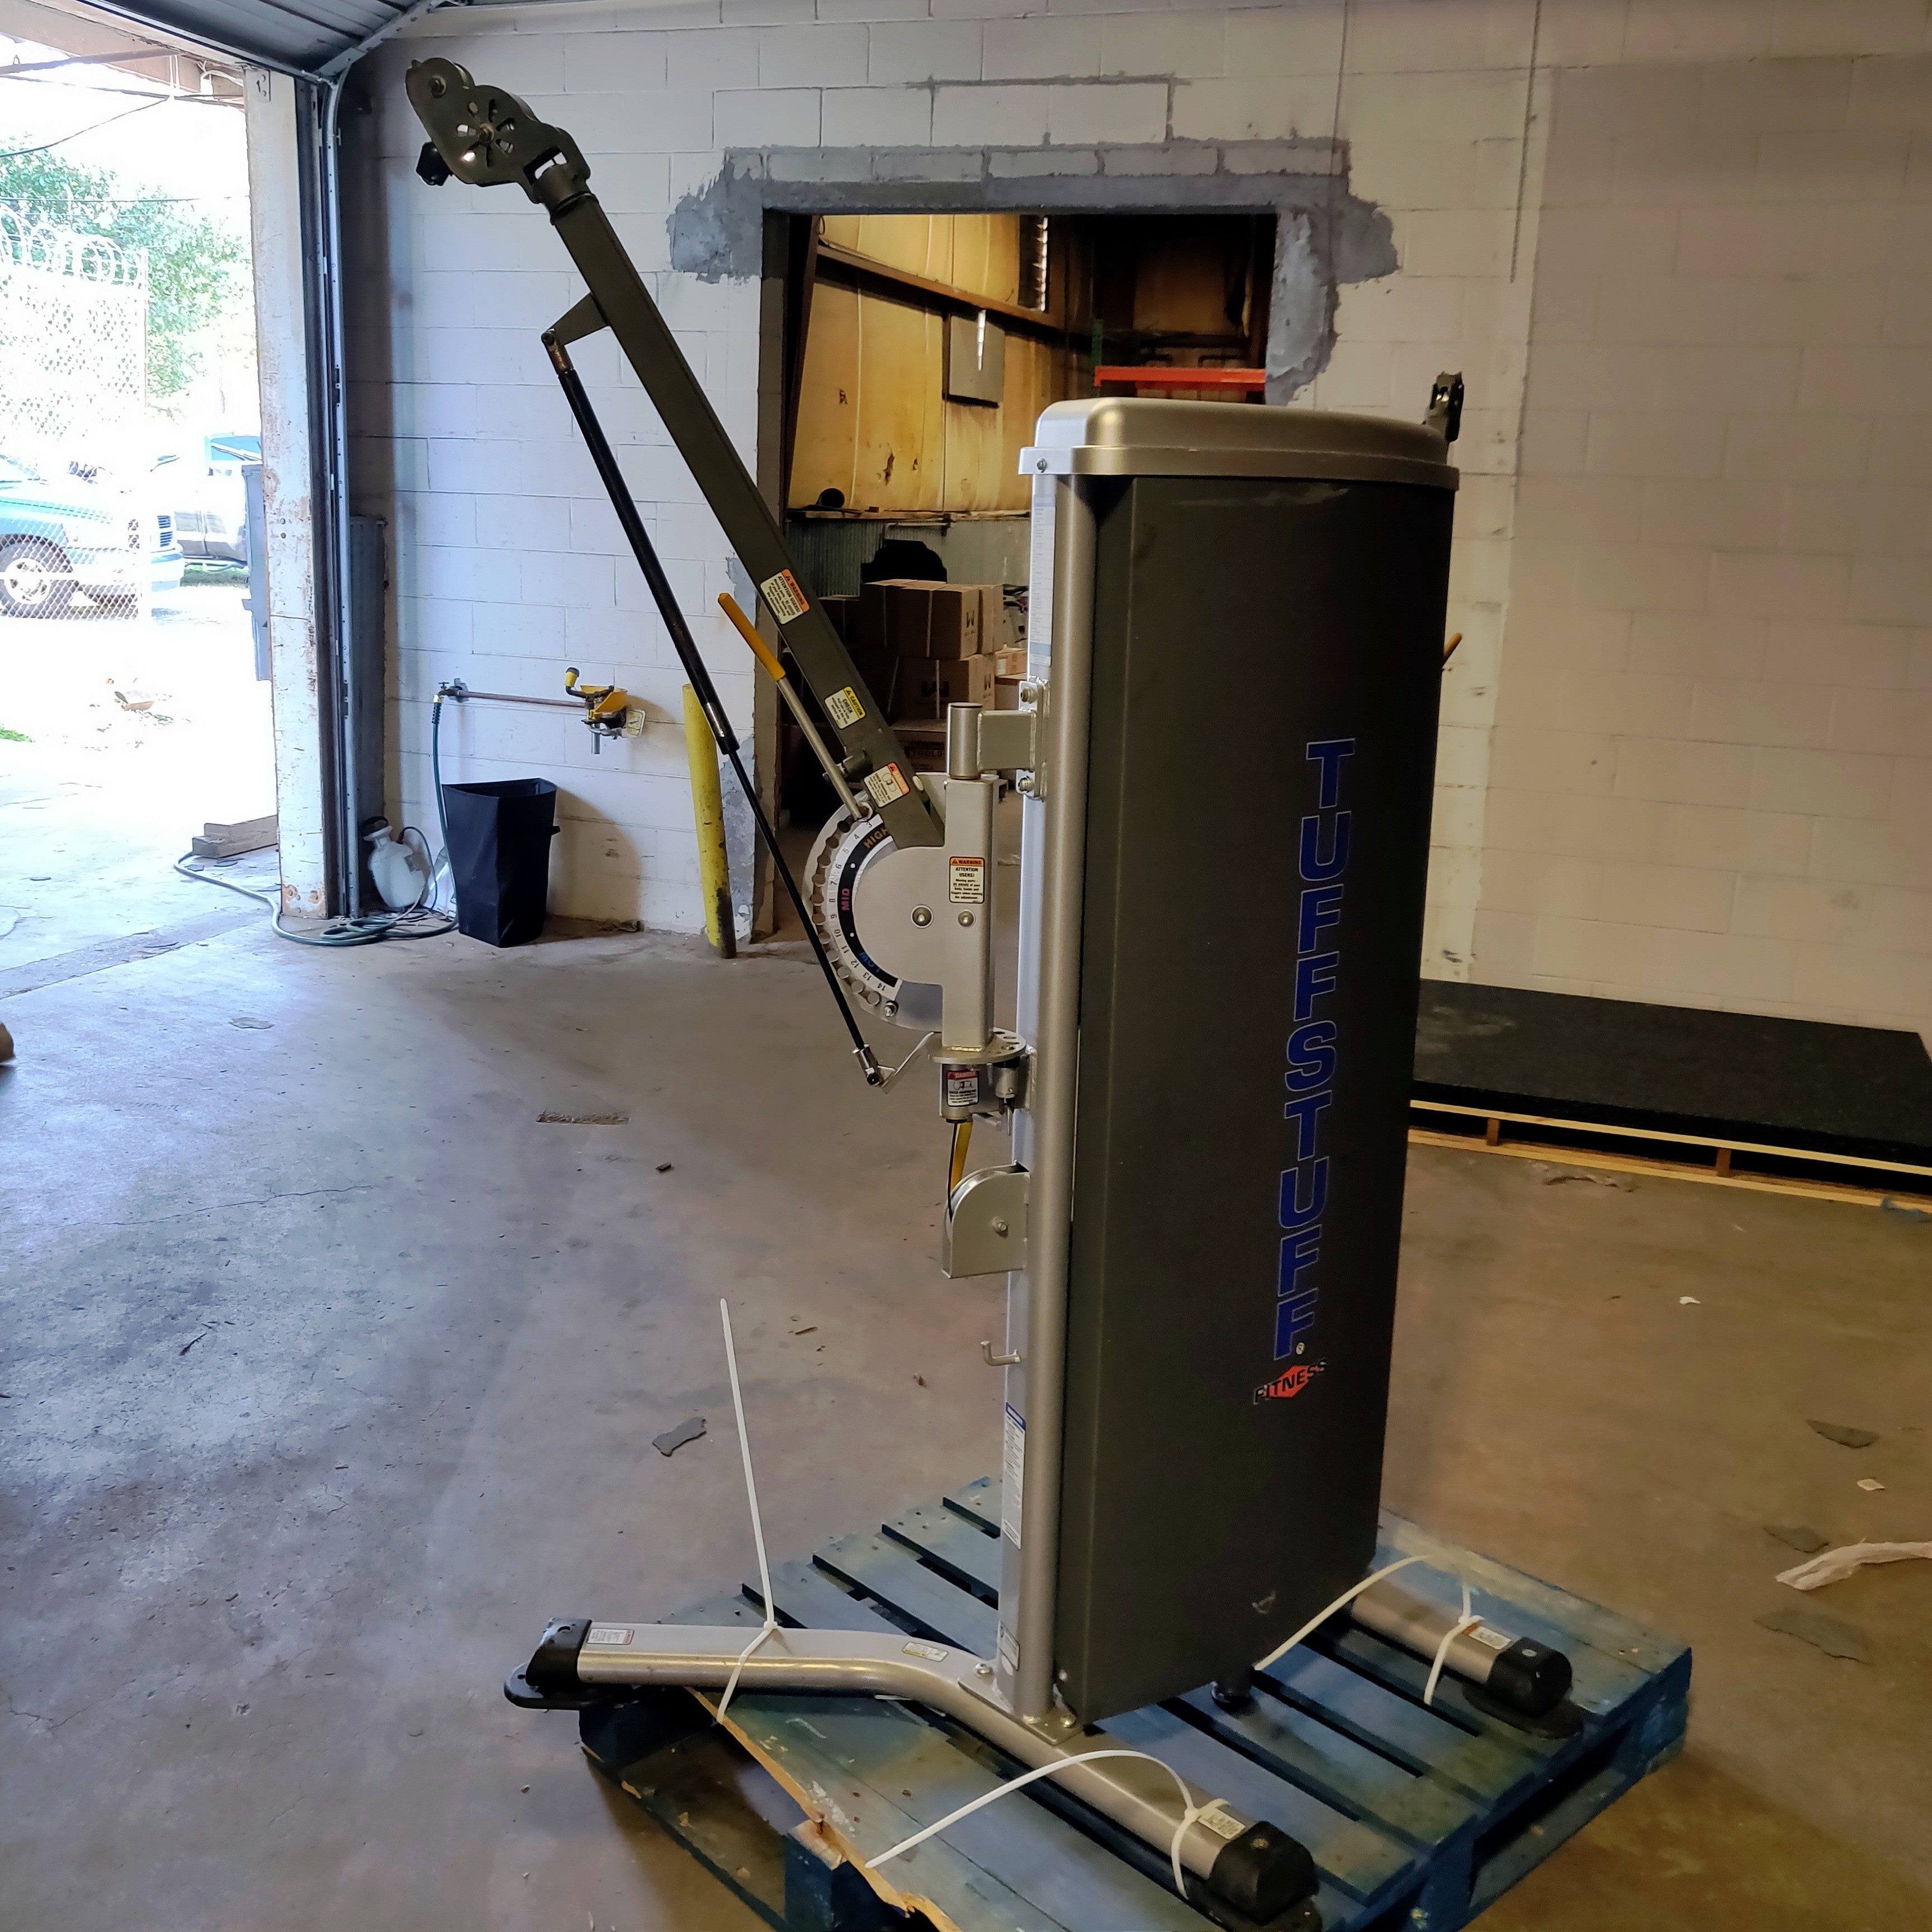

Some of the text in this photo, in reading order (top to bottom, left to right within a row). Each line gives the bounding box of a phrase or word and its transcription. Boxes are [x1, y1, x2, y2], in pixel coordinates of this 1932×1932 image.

[778, 575, 800, 613] ATTENTION USERS!
[789, 581, 804, 605] WARNING
[842, 698, 853, 713] CHECK
[850, 695, 863, 716] CAUTION
[841, 888, 850, 911] MID
[834, 929, 841, 937] 10
[841, 945, 850, 954] 11
[850, 959, 859, 968] 12
[863, 972, 872, 981] 13
[877, 982, 886, 991] 14
[1274, 738, 1355, 1361] TUFFSTUFF
[1253, 1357, 1328, 1405] FITNESS
